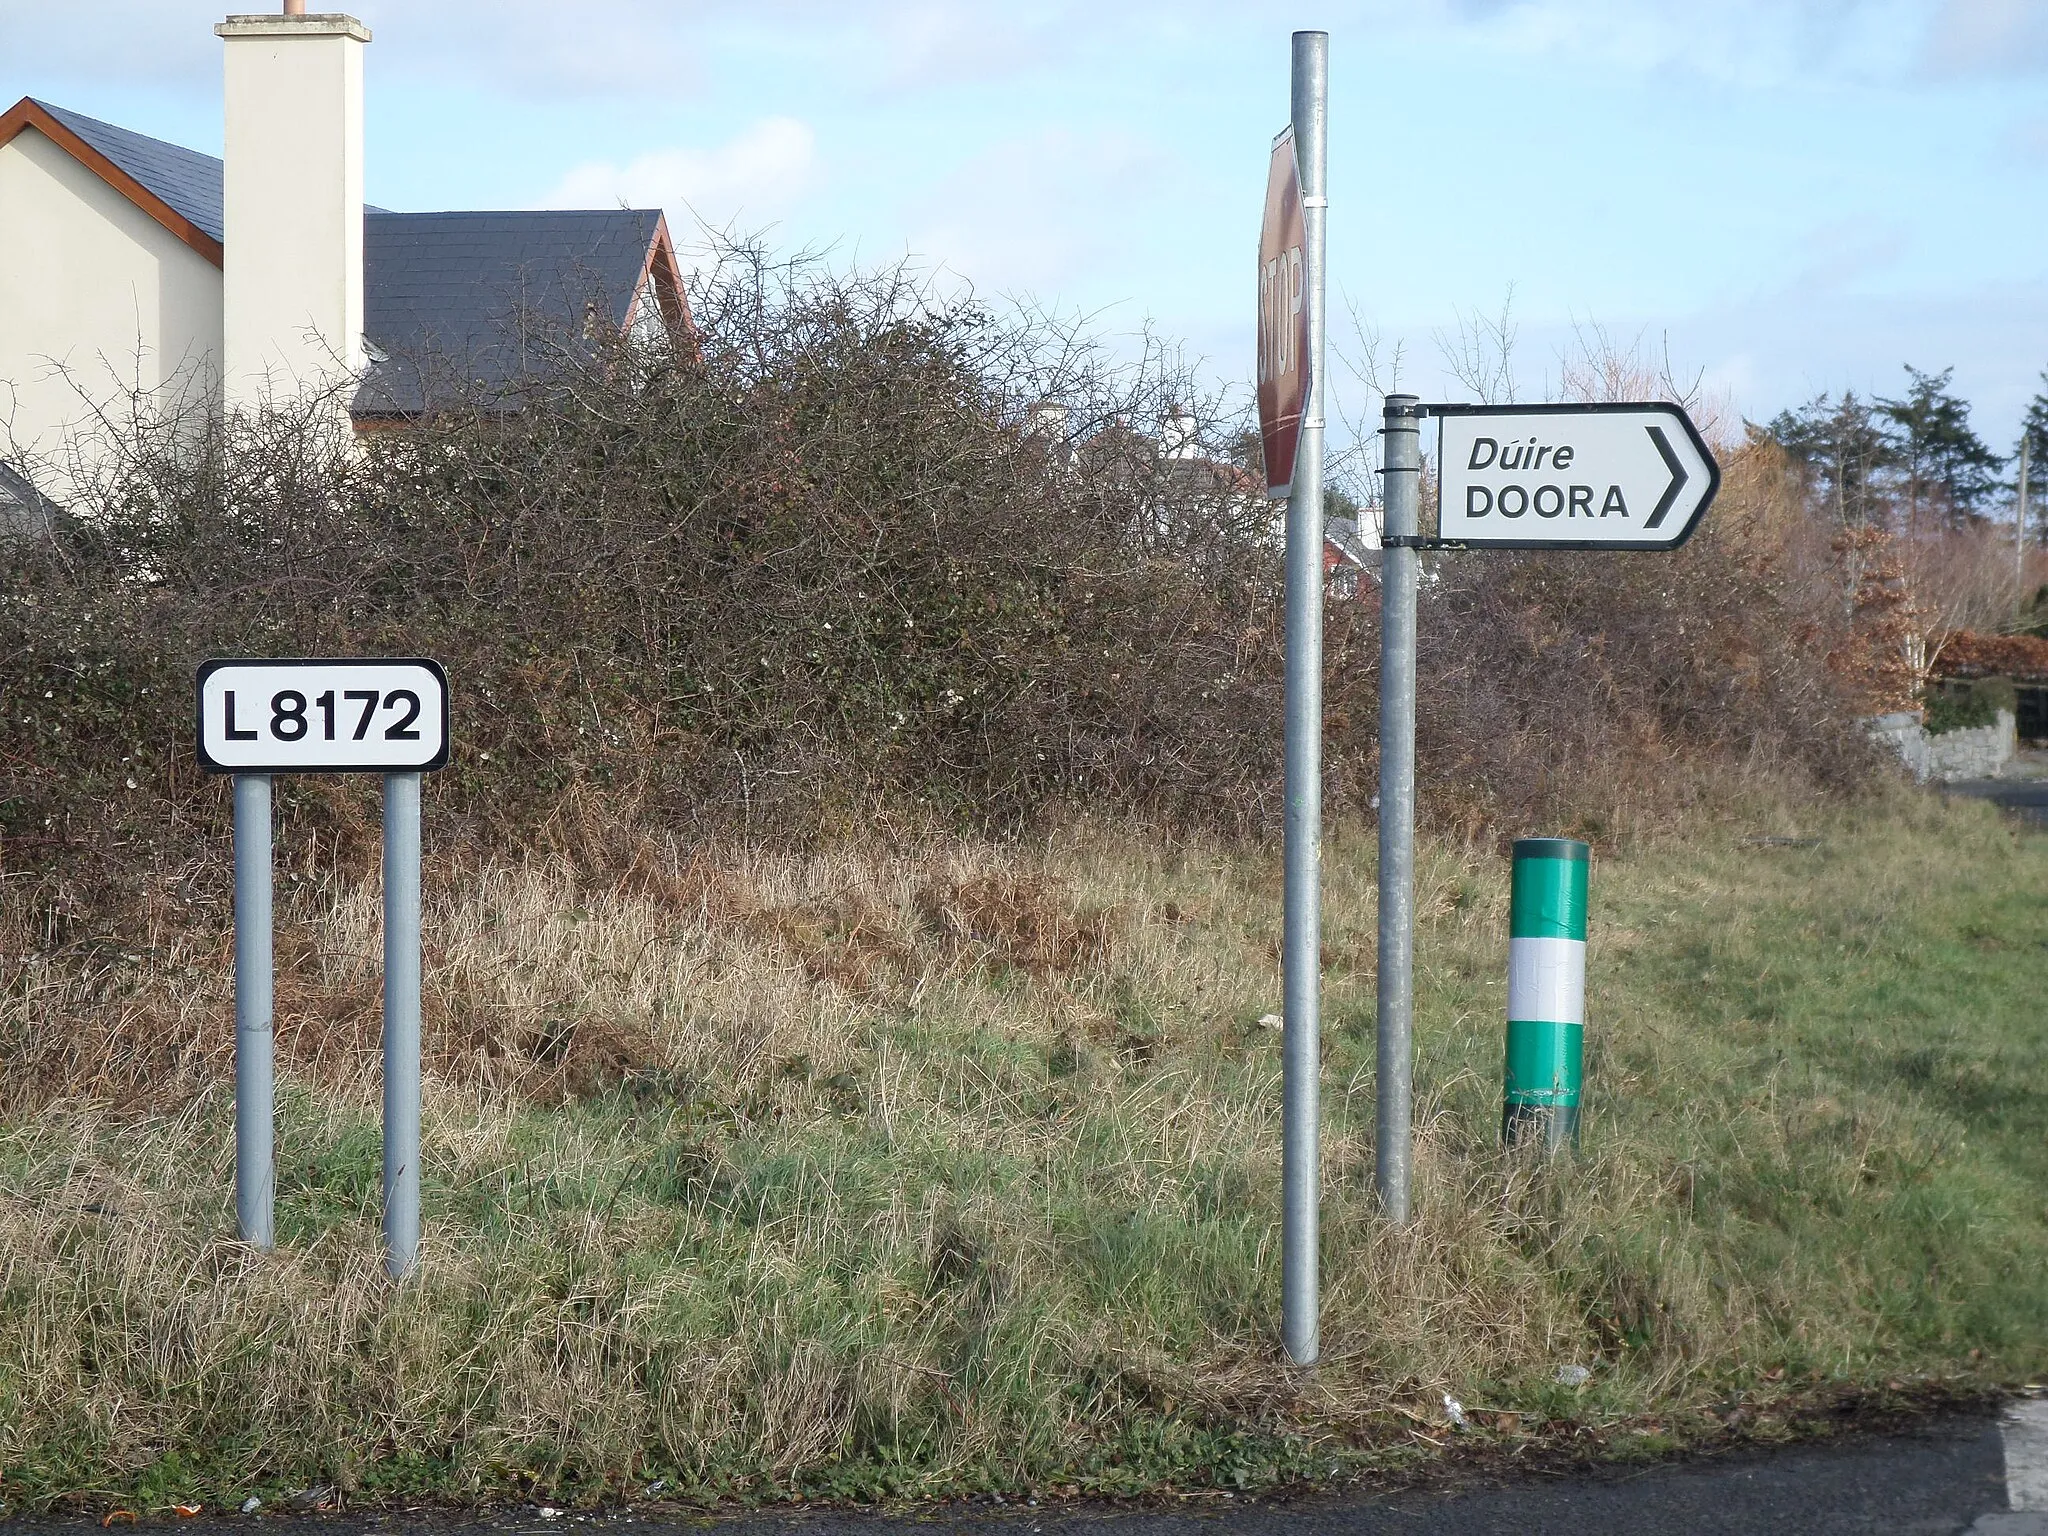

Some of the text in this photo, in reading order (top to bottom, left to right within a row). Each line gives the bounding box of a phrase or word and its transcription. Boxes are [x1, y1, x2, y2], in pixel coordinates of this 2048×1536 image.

[1259, 246, 1303, 385] STOP
[1467, 437, 1574, 470] Dúire
[1466, 485, 1630, 518] DOORA
[224, 689, 421, 742] L 8172
